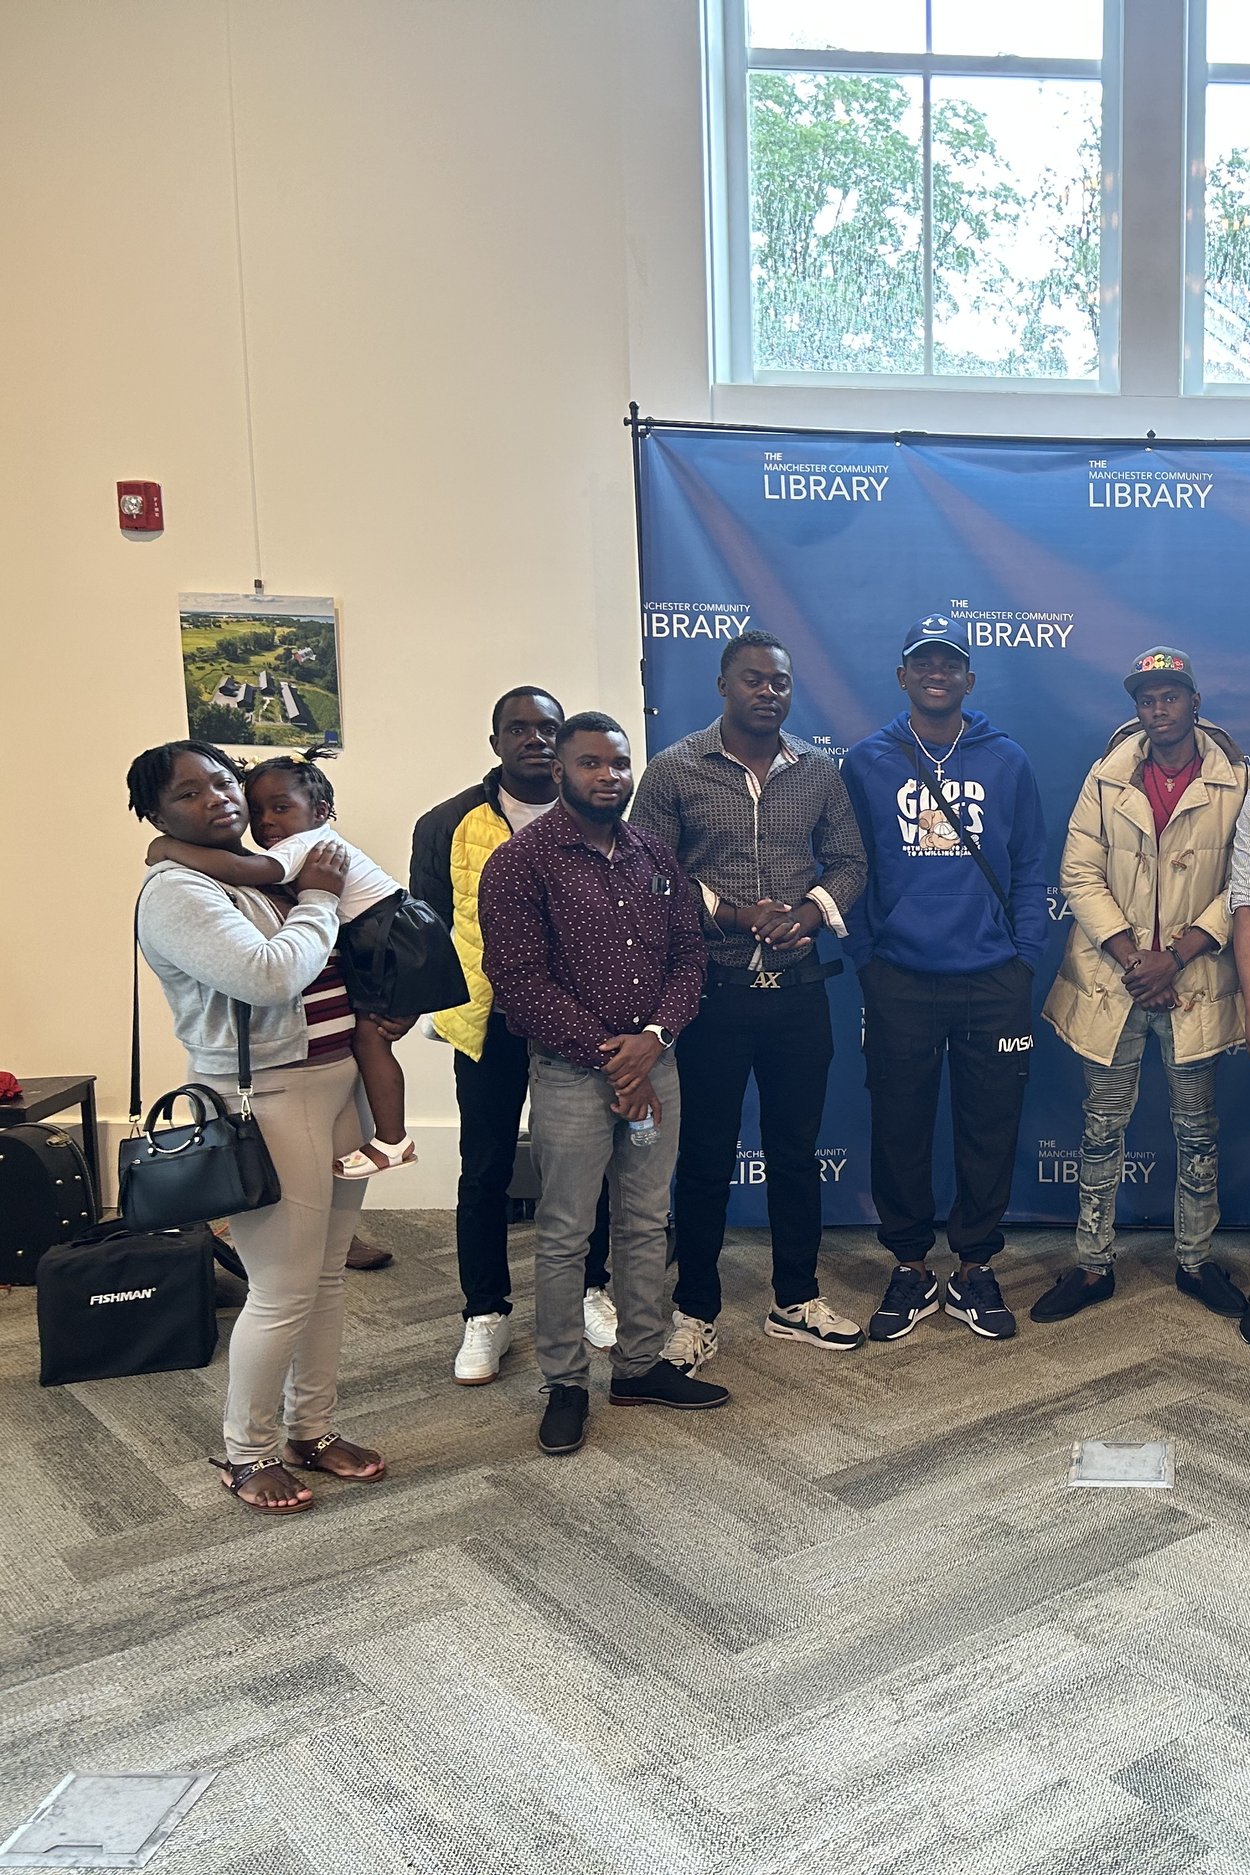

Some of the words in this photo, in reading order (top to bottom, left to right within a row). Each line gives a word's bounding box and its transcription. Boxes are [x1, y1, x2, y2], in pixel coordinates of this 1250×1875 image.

[764, 452, 782, 460] THE
[764, 463, 827, 472] MANCHESTER
[829, 464, 889, 473] COMMUNITY
[1089, 460, 1107, 468] THE
[1089, 471, 1153, 480] MANCHESTER
[1154, 472, 1213, 481] COMMUNITY
[764, 475, 889, 501] LIBRARY
[1089, 483, 1213, 508] LIBRARY
[692, 603, 750, 612] COMMUNITY
[950, 611, 1013, 620] MANCHESTER
[1015, 612, 1074, 621] COMMUNITY
[967, 622, 1074, 648] IBRARY
[812, 736, 831, 744] THE
[749, 971, 783, 989] AX
[998, 1035, 1034, 1052] NASA
[1039, 1140, 1056, 1148] THE
[1038, 1150, 1082, 1158] MANCHES
[1038, 1161, 1156, 1184] LIBRY
